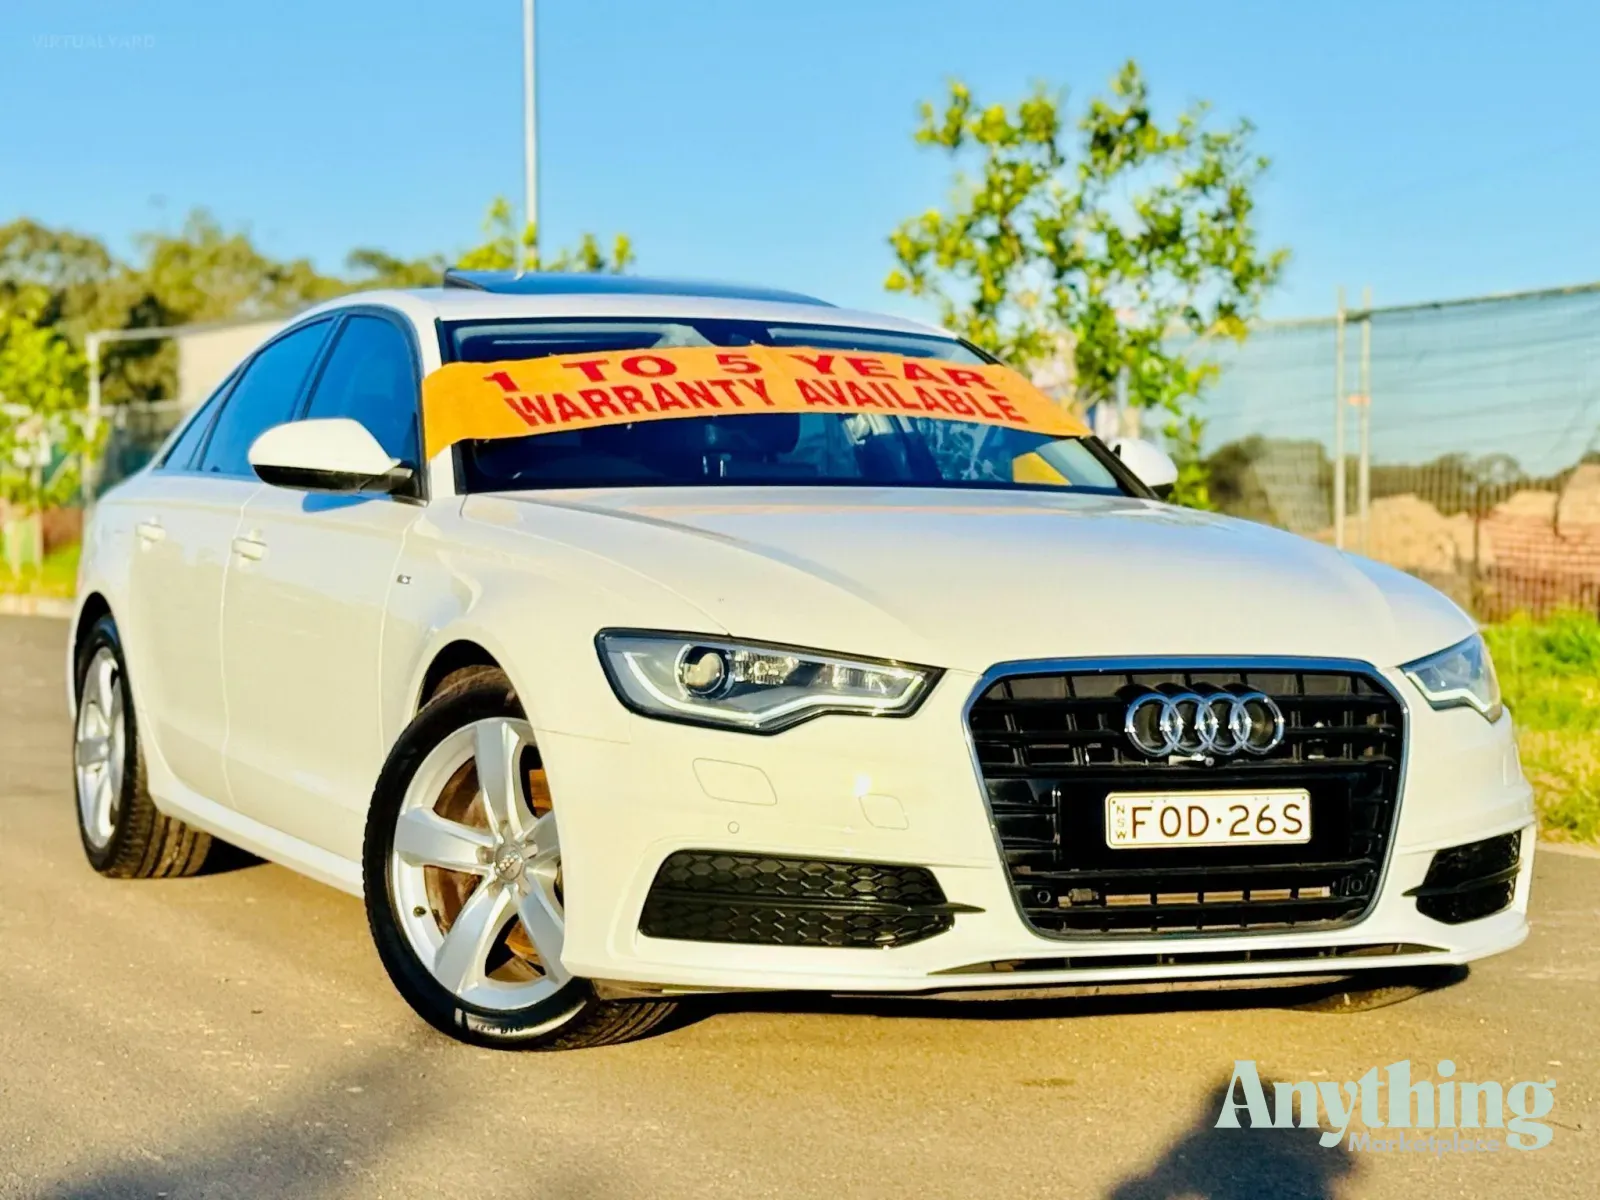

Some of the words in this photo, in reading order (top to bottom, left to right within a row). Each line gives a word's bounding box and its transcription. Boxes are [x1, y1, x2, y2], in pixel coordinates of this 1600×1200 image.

[483, 371, 520, 393] 1
[560, 355, 678, 382] TO
[715, 354, 763, 374] 5
[787, 354, 1000, 391] YEAR
[504, 378, 776, 427] WARRANTY
[795, 378, 1030, 424] AVAILABLE
